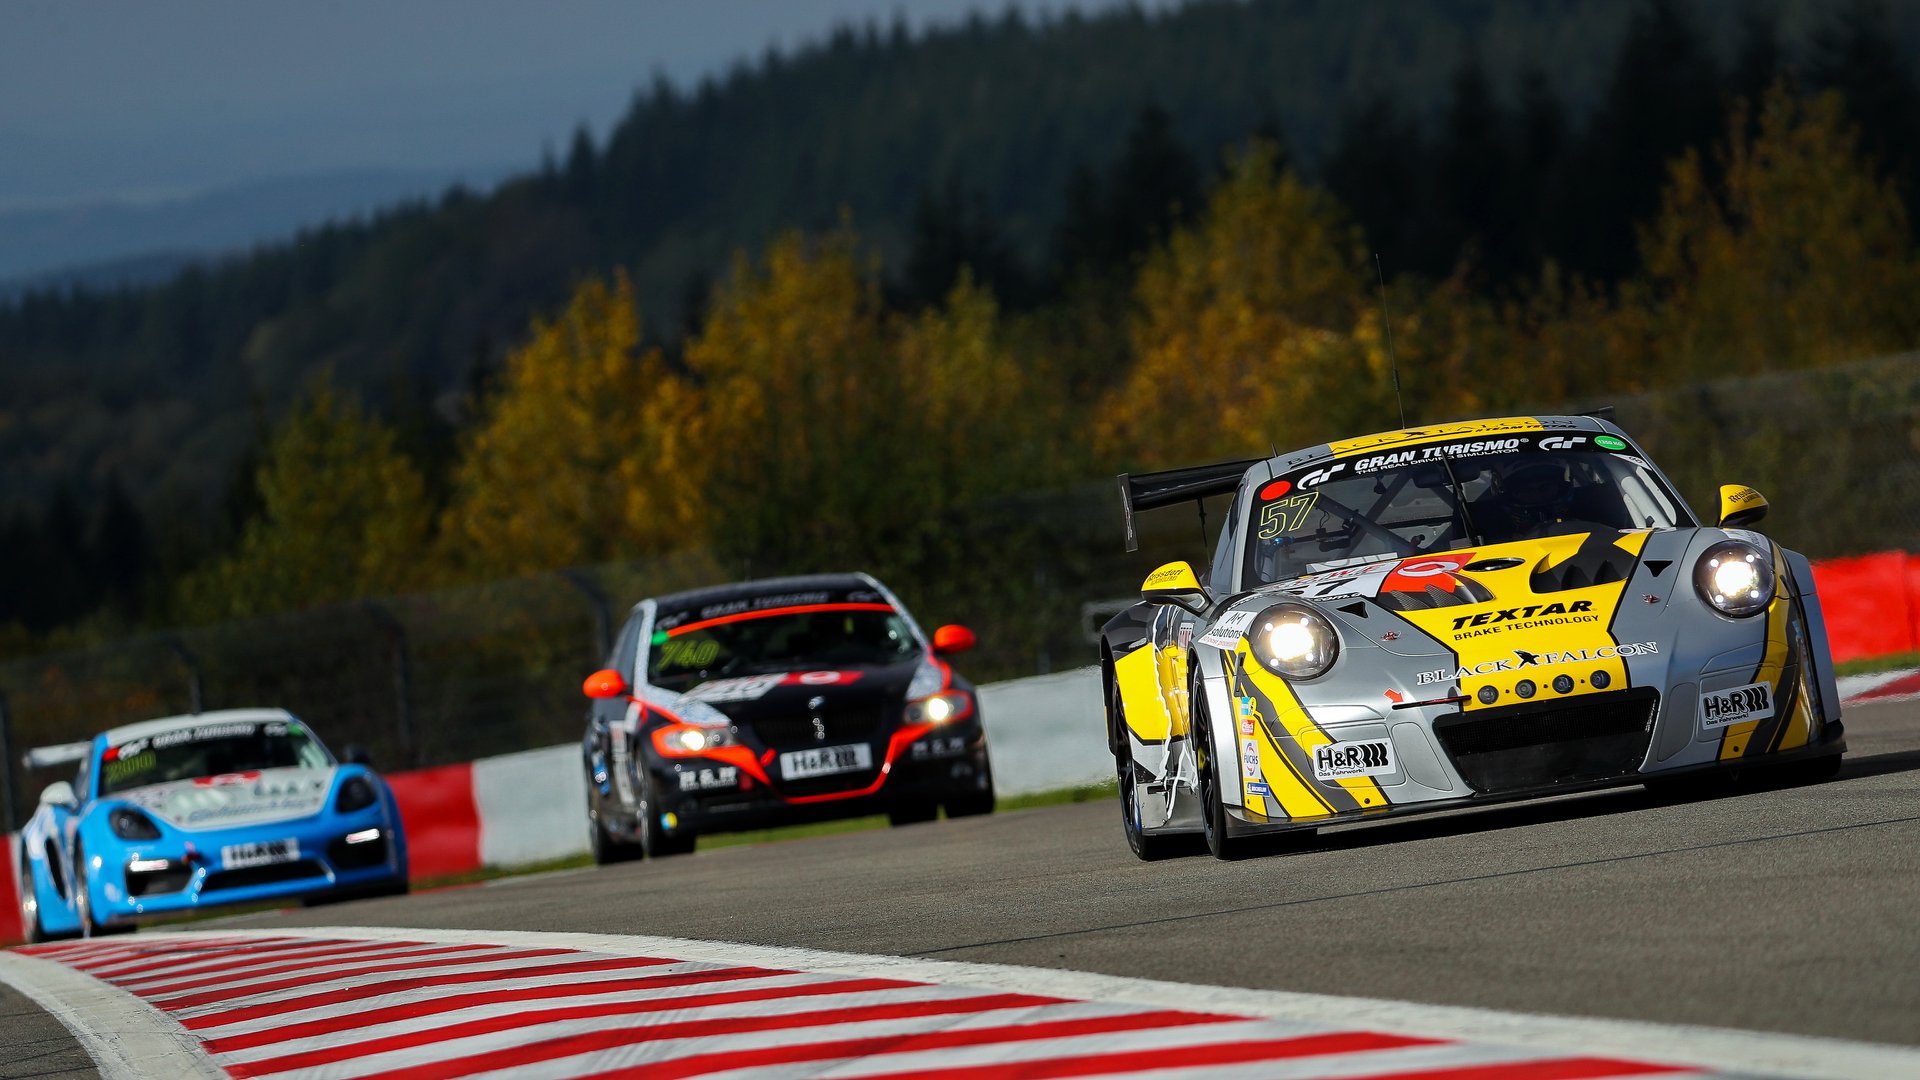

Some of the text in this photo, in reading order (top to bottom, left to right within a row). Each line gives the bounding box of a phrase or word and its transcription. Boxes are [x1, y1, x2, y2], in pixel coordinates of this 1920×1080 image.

[1354, 438, 1520, 471] GRAN TURISMO
[1356, 467, 1378, 475] THE
[1380, 461, 1409, 471] REAL
[1456, 448, 1520, 460] SIMULATOR
[1258, 491, 1320, 540] 57
[1452, 600, 1593, 631] TEXTAR
[1454, 614, 1600, 641] BRAKE TECHNOLOGY
[1208, 626, 1243, 639] solutions
[1416, 641, 1659, 686] BLACK FALCON
[1703, 690, 1750, 720] H&R
[1243, 754, 1258, 765] FUCHS
[1316, 746, 1365, 772] H&R
